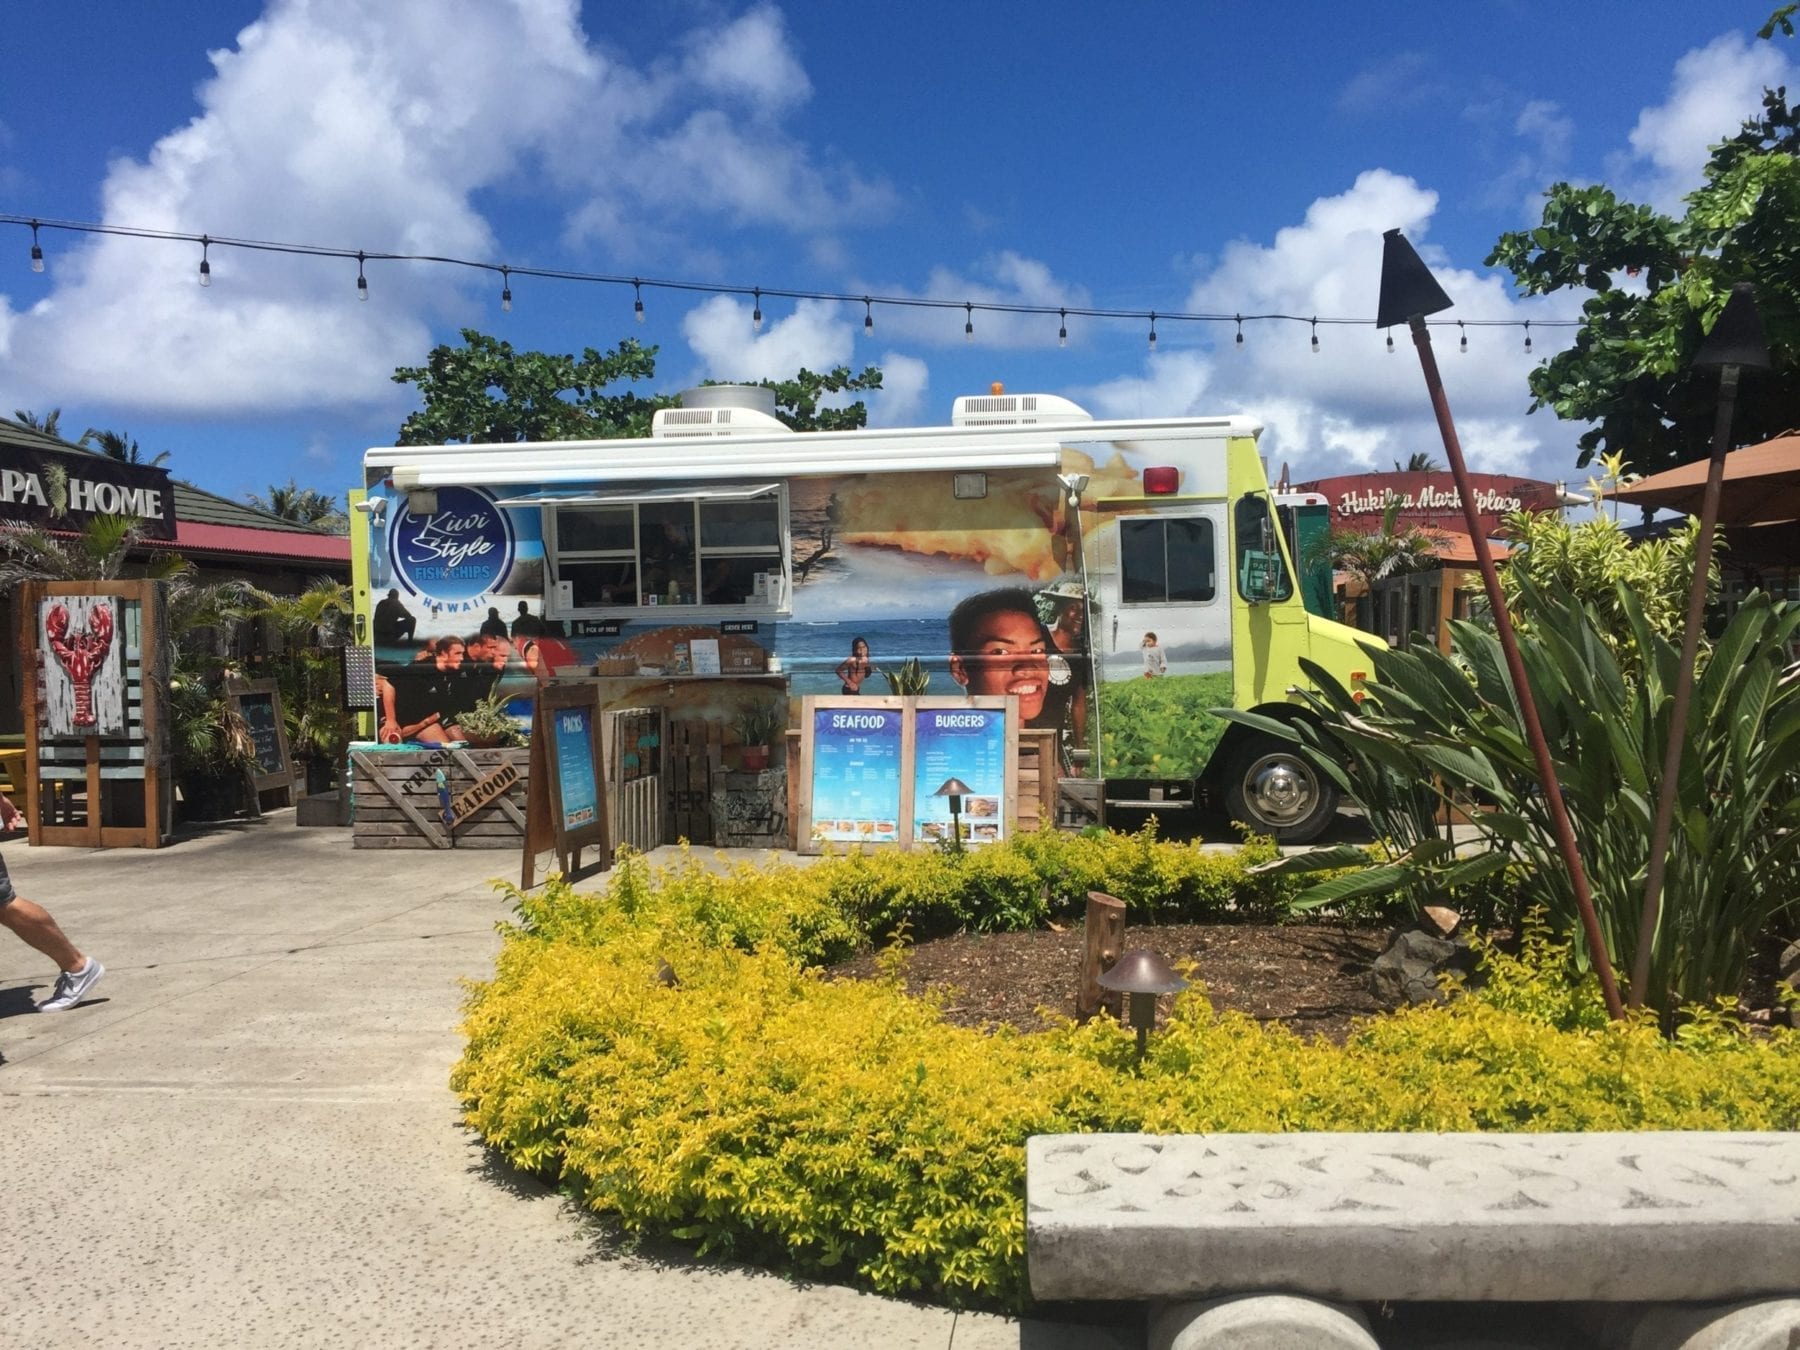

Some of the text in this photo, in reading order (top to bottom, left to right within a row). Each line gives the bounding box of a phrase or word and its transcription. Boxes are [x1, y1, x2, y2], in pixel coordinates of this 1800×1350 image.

[0, 468, 164, 520] PA HOME
[1416, 485, 1522, 514] Marktplace
[406, 511, 490, 538] Kiwi
[407, 535, 496, 568] Style
[415, 567, 442, 580] FISH
[451, 565, 491, 580] CHIPS
[423, 595, 487, 613] HAWAII
[562, 714, 584, 733] PACKS
[832, 714, 886, 729] SEAFOOD
[935, 714, 985, 728] BURGERS
